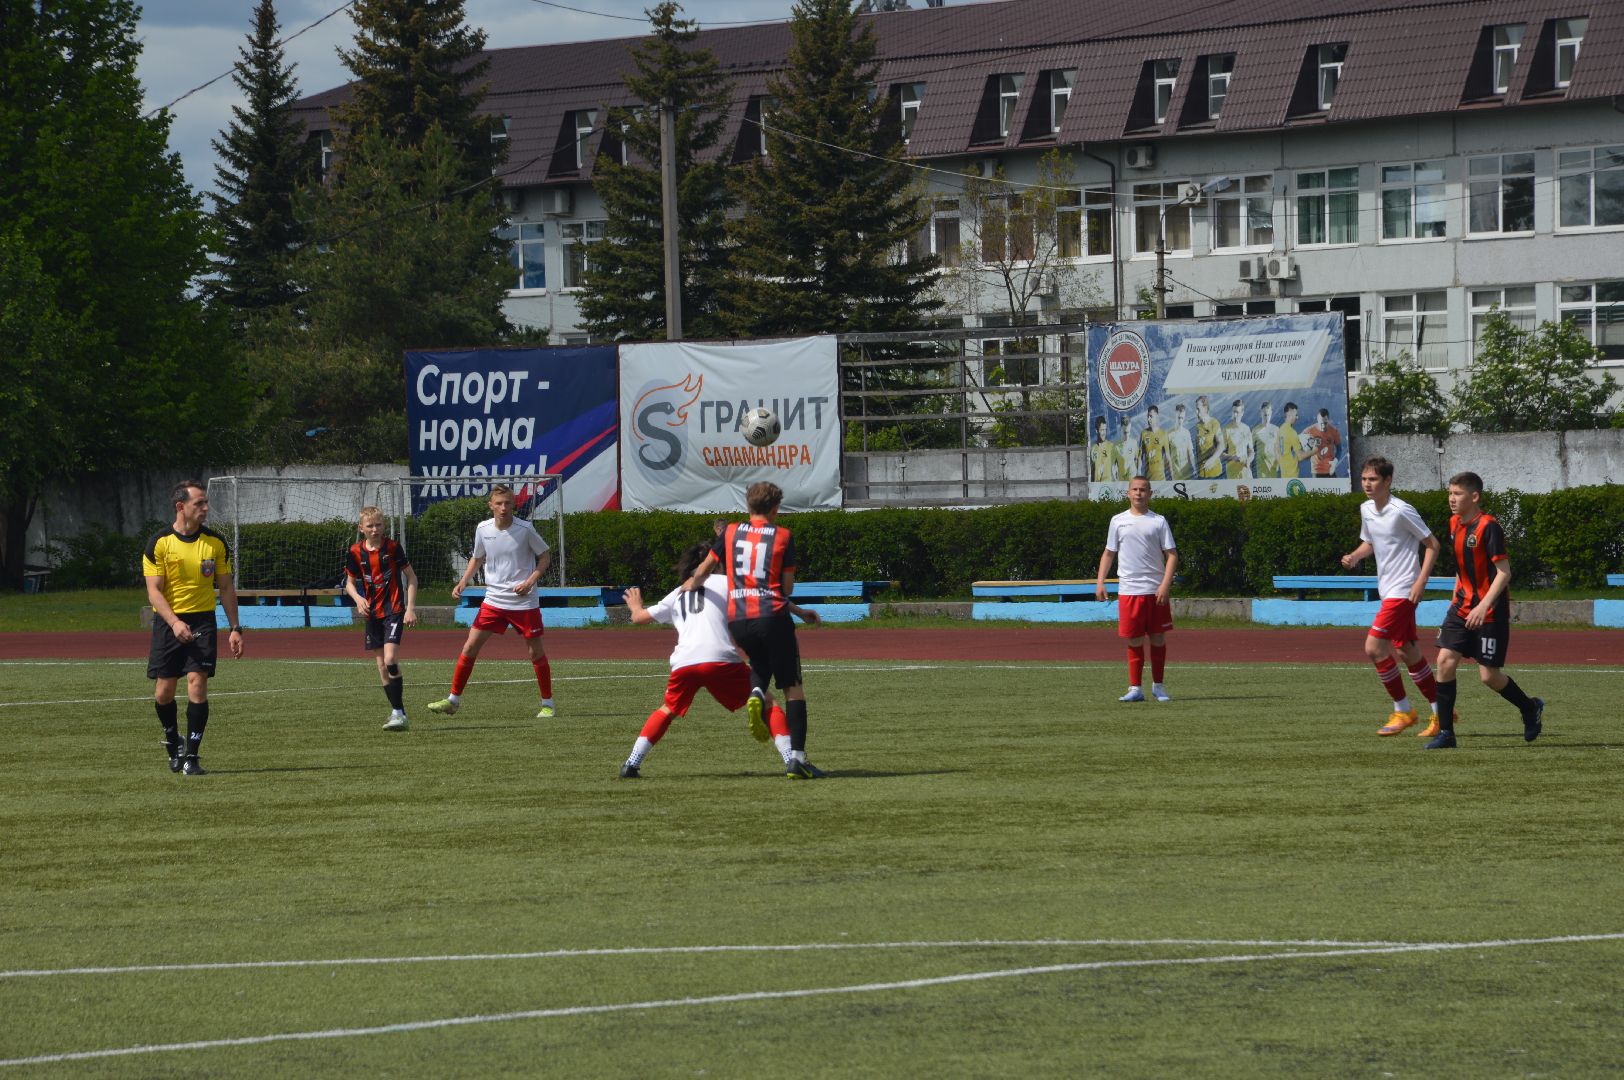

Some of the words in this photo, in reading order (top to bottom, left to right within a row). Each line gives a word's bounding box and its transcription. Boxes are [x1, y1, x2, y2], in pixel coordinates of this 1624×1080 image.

[1186, 343, 1207, 353] Наша
[1255, 340, 1274, 350] Наш
[1109, 361, 1141, 370] ШАТУРА
[1217, 356, 1244, 367] только
[1221, 370, 1267, 381] ЧЕМПИОН
[416, 364, 529, 414] Спорт
[419, 417, 536, 461] норма
[702, 444, 811, 469] САЛАМАНДРА
[420, 455, 548, 497] жизни!
[735, 540, 767, 579] 31
[390, 623, 398, 635] 7
[1481, 637, 1497, 655] 19
